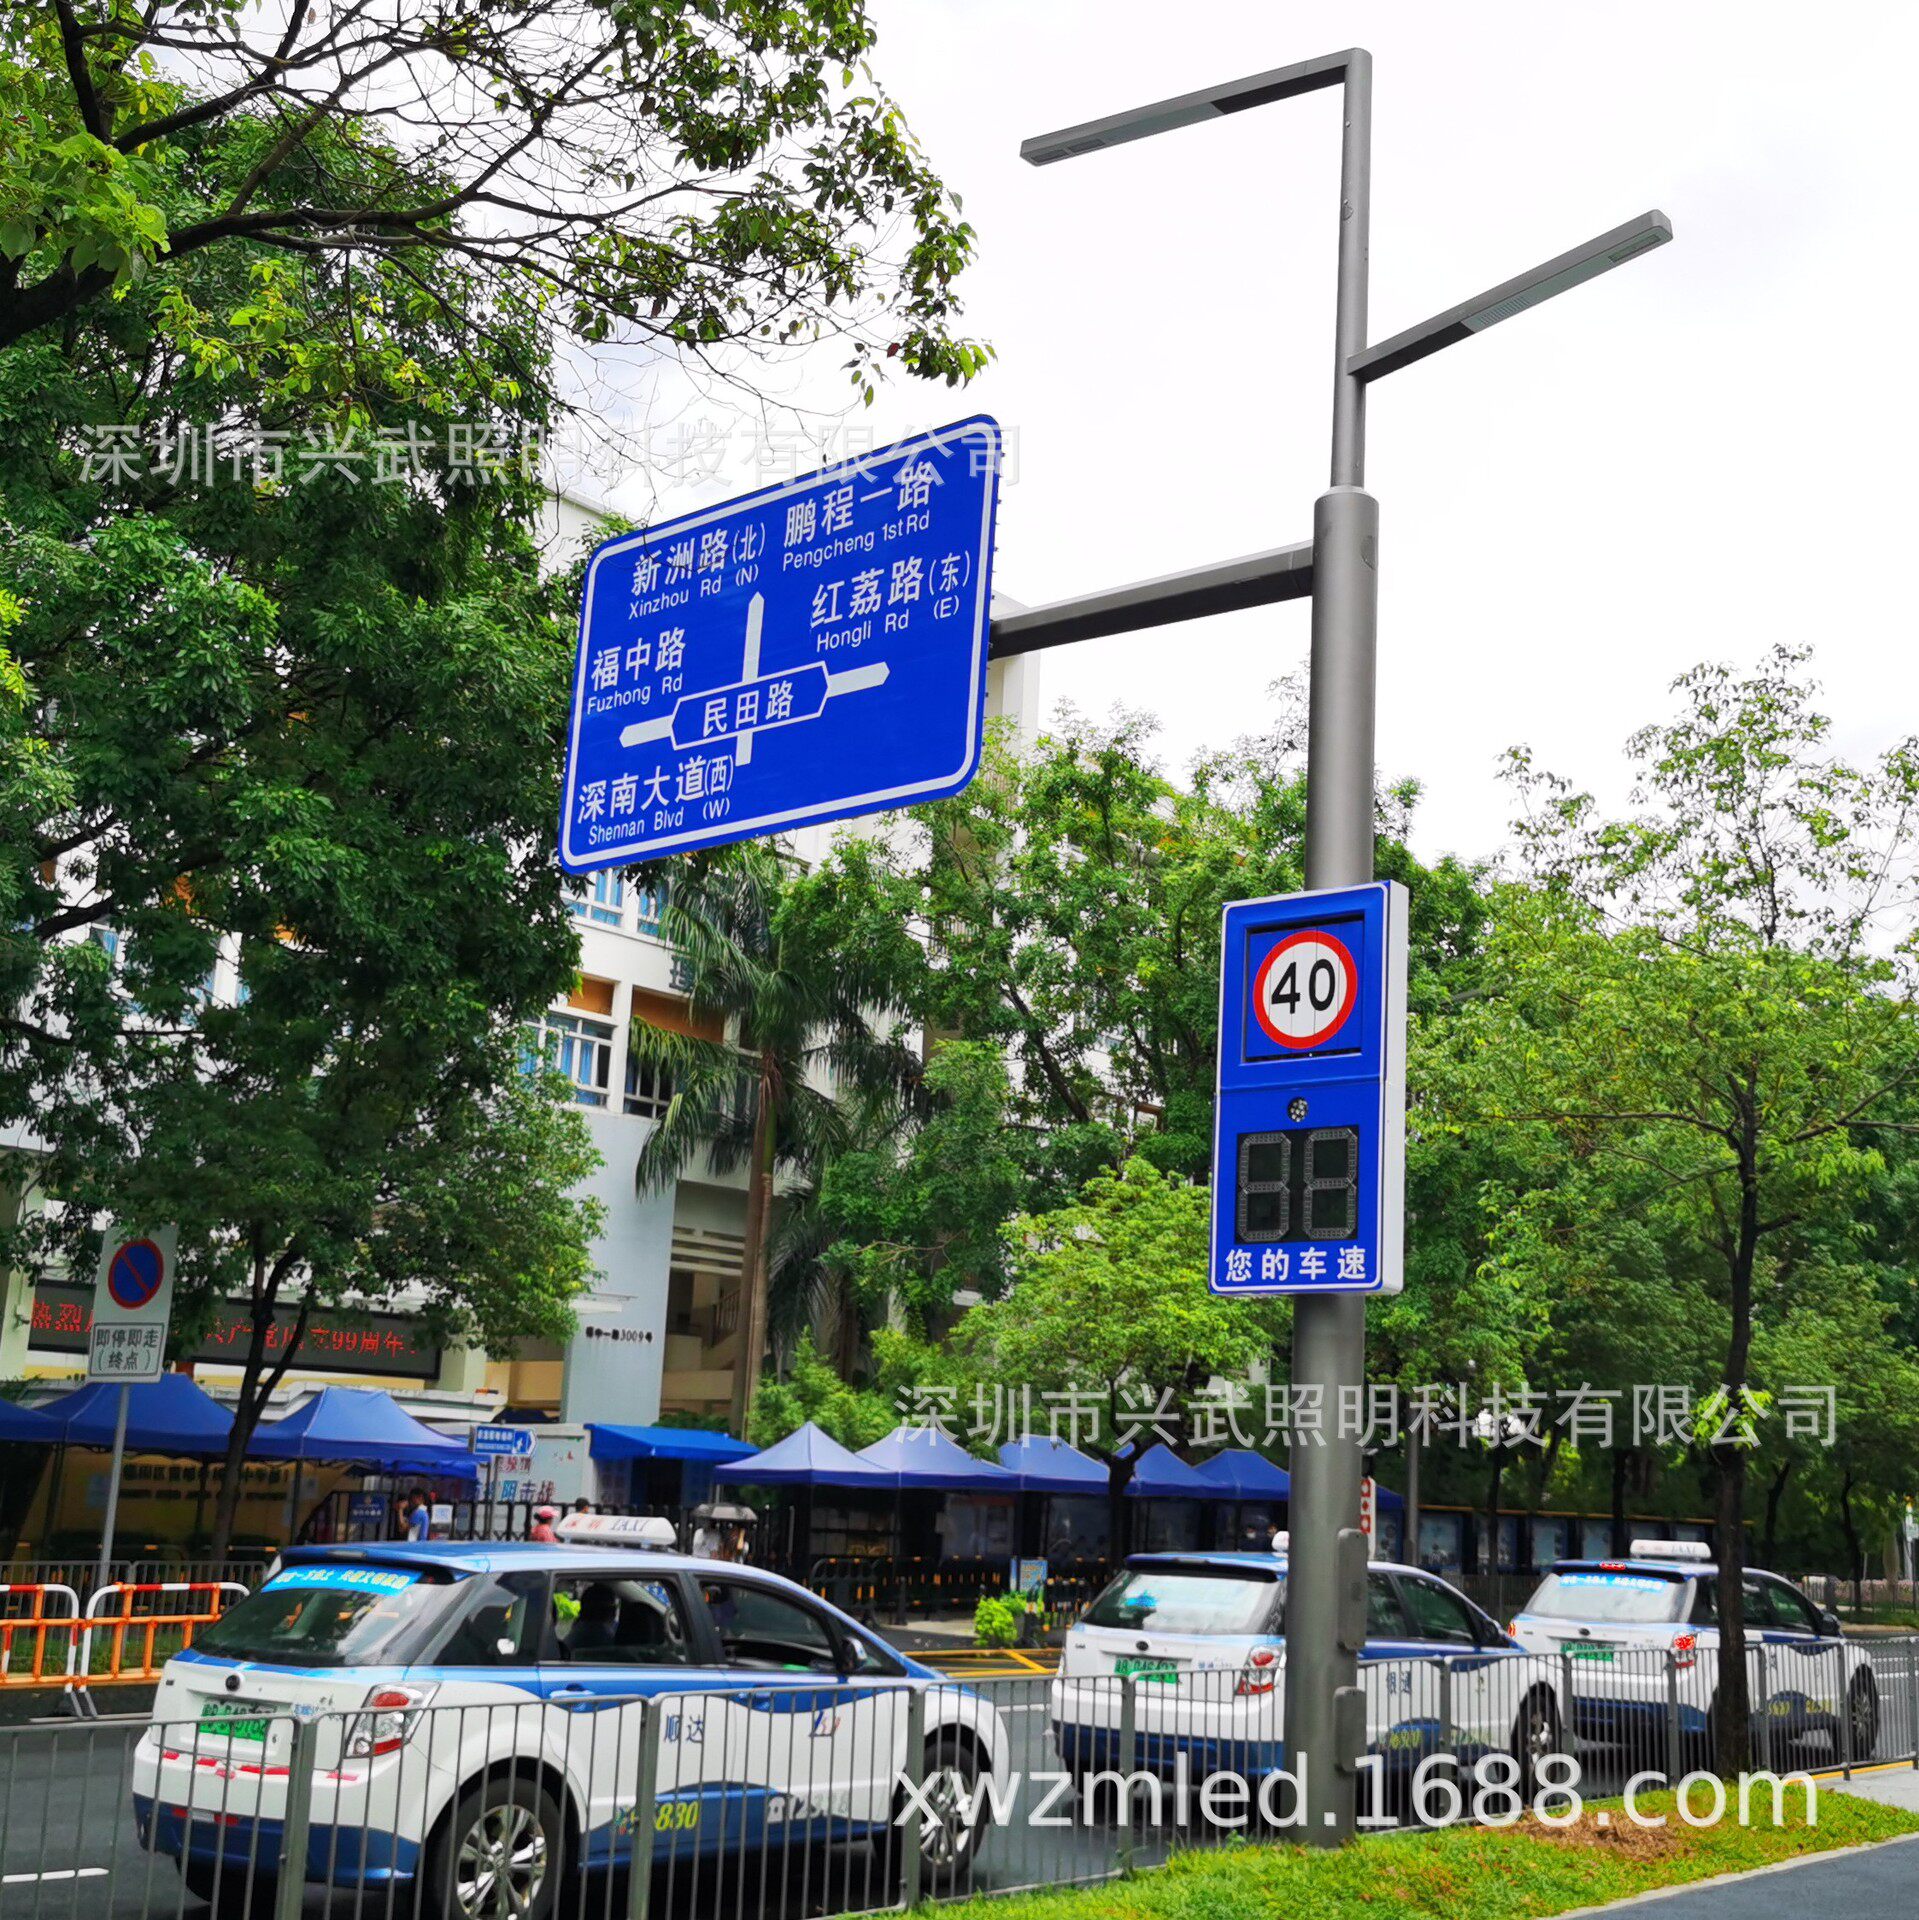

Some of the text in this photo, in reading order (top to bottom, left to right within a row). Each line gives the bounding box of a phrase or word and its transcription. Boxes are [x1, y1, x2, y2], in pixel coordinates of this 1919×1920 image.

[783, 461, 933, 548] 鹏程一路
[783, 510, 930, 571] Pengcheng 1st Rd
[628, 563, 759, 620] Xinzhou Rd (N)
[816, 595, 960, 652] Hongli Rd (E)
[591, 626, 686, 692] 福中路
[587, 673, 683, 715] Fuzhong Rd
[702, 680, 794, 737] 民田路
[588, 798, 731, 846] Shennan Blvd (W)
[1271, 958, 1336, 1014] 40
[1225, 1244, 1367, 1282] 您的车速
[96, 1328, 159, 1348] 即停即走
[664, 1714, 705, 1743] 顺达
